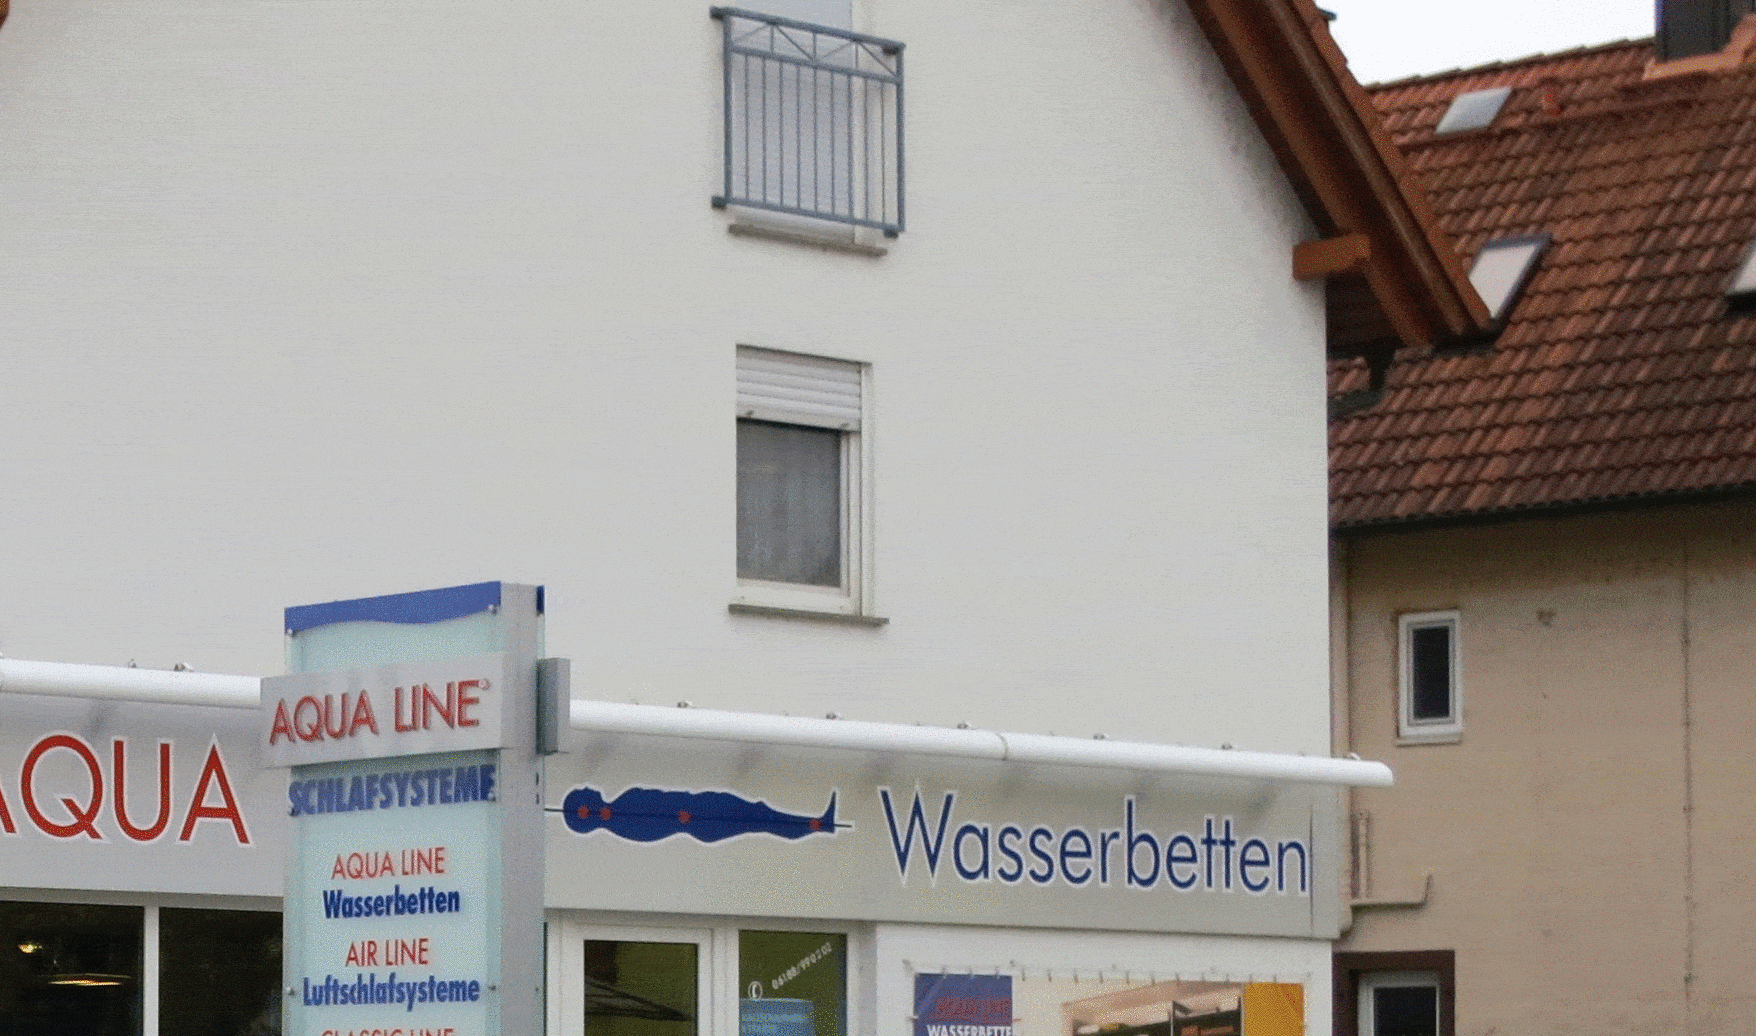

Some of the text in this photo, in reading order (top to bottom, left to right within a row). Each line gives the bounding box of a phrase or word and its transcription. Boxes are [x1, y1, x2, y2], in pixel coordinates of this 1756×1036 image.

[269, 689, 380, 745] AQUA
[288, 764, 496, 815] SCHLAFSYSTEME
[877, 781, 1311, 897] Wasserbetten
[331, 847, 446, 880] AQUA LINE
[323, 884, 461, 919] Wasserbetten
[345, 938, 430, 967] AIR LINE
[302, 972, 481, 1012] Luftschlafsysteme
